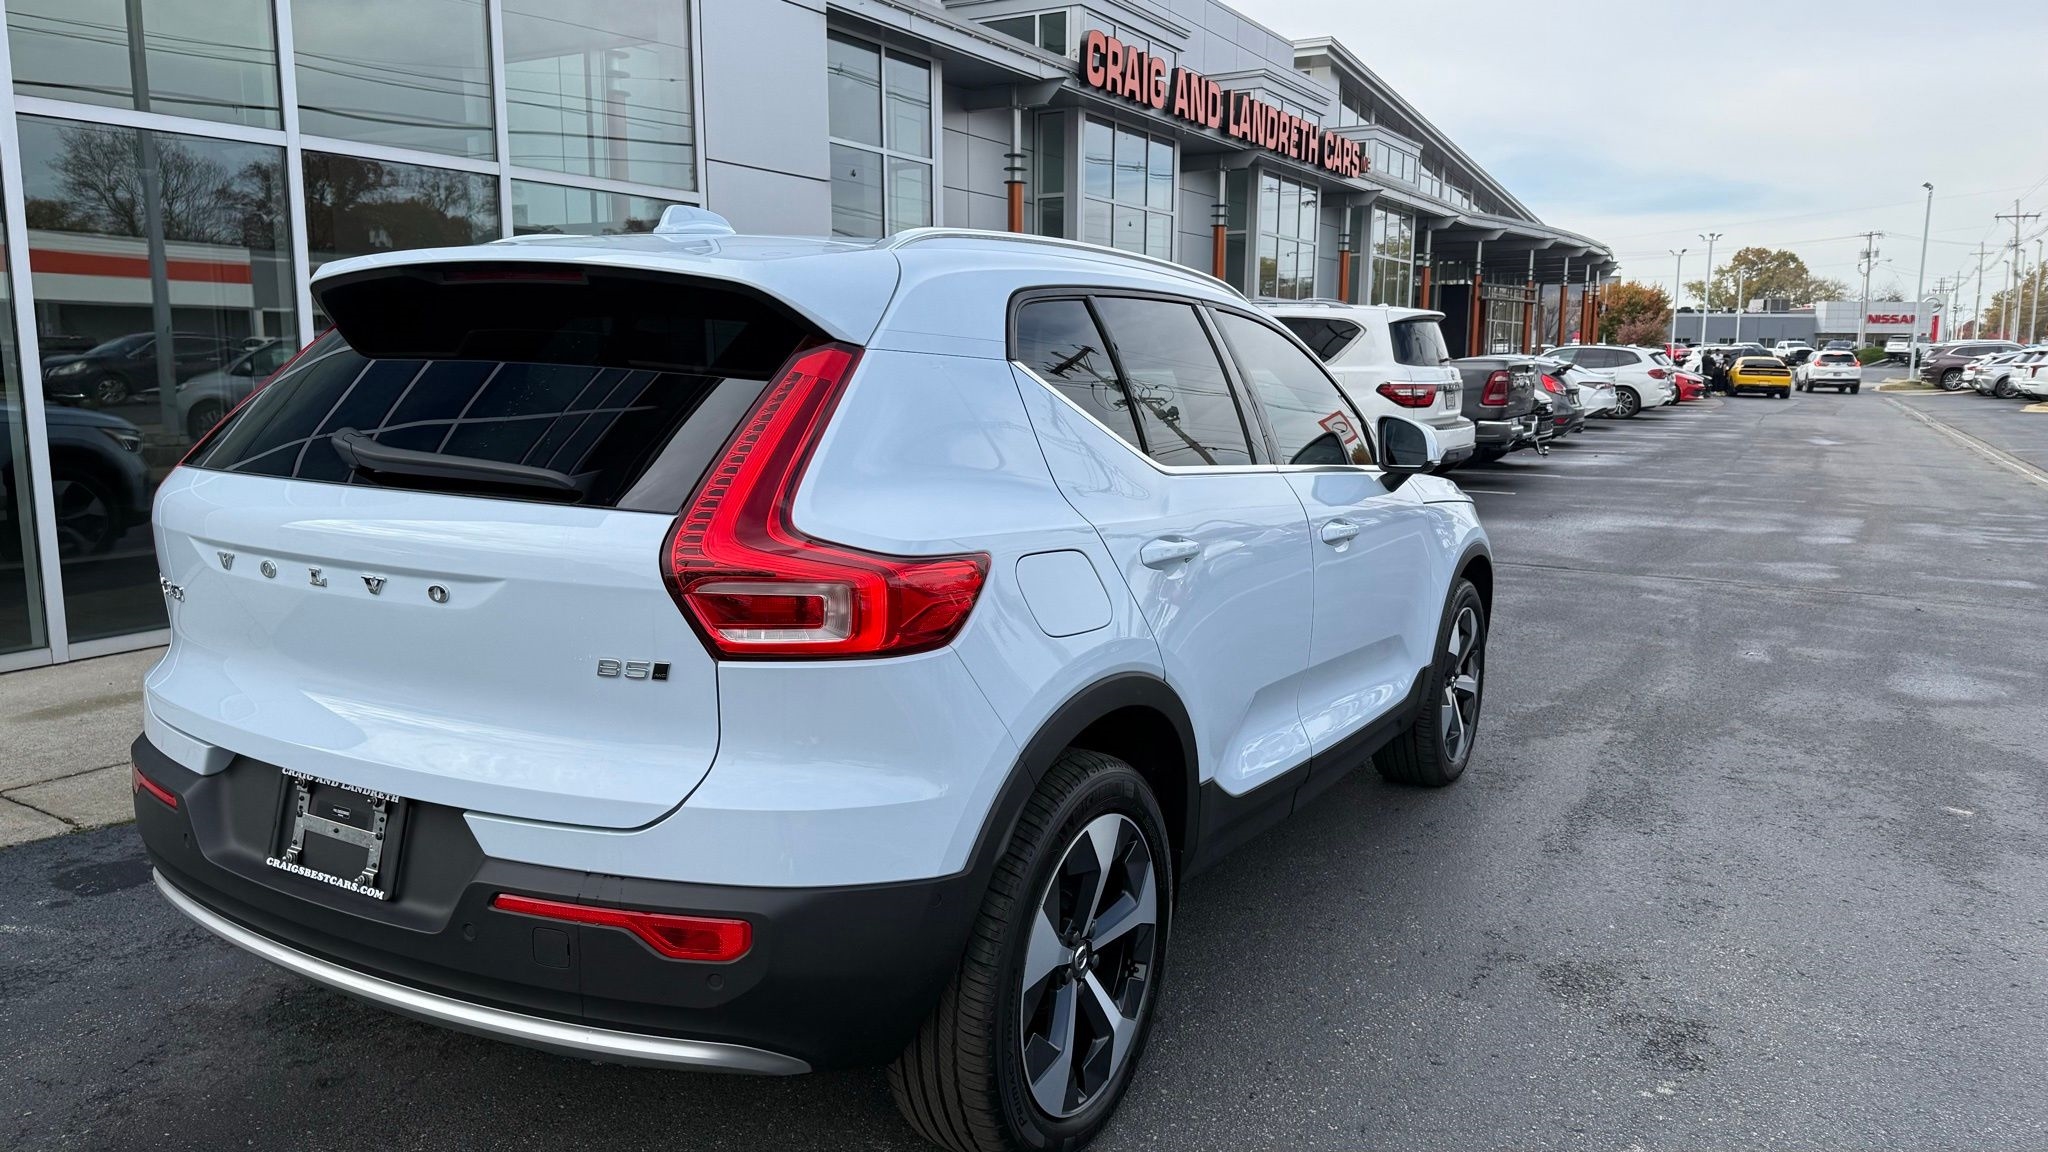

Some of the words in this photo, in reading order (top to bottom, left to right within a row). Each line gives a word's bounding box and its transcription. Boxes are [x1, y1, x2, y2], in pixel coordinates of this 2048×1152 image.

[1082, 29, 1166, 109] CRAIG
[1172, 67, 1222, 129] AND
[1226, 90, 1319, 164] LANDRETH
[1322, 130, 1360, 178] CARS
[217, 551, 450, 603] VOLVO
[597, 658, 650, 679] B5
[266, 857, 385, 900] CRAIGSBESTCARS.COM
